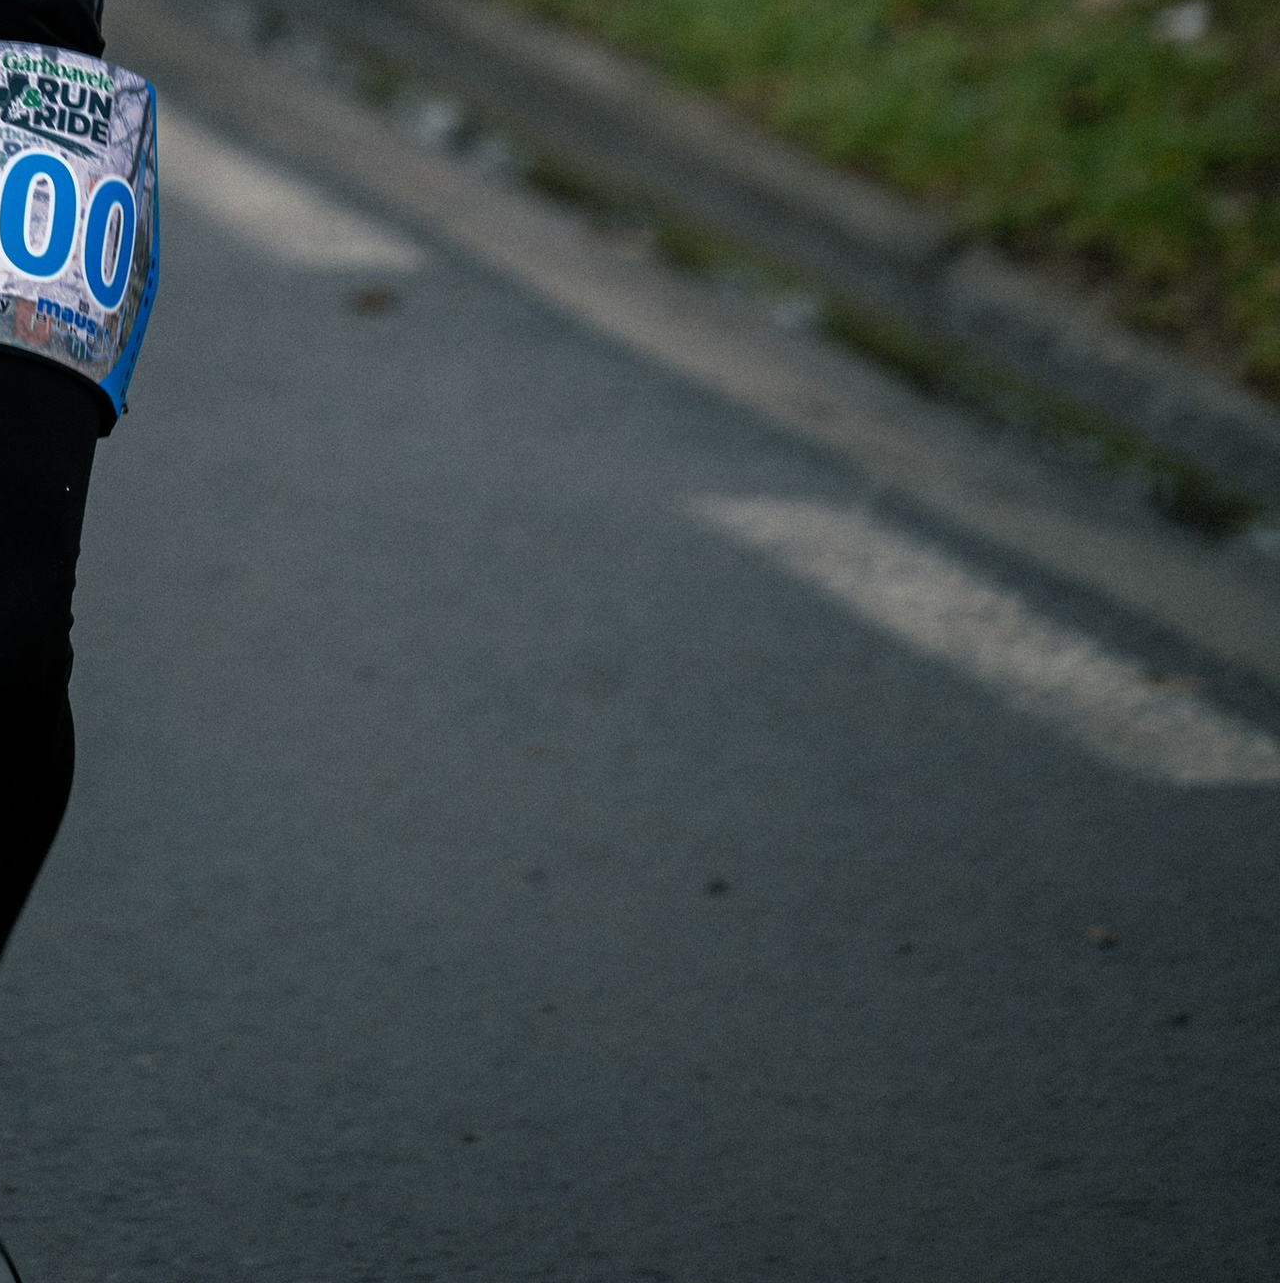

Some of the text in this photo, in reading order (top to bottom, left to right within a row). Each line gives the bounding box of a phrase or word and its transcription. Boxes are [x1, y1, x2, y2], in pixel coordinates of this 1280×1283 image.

[23, 87, 43, 109] &
[37, 75, 113, 121] RUN
[33, 107, 109, 148] RIDE
